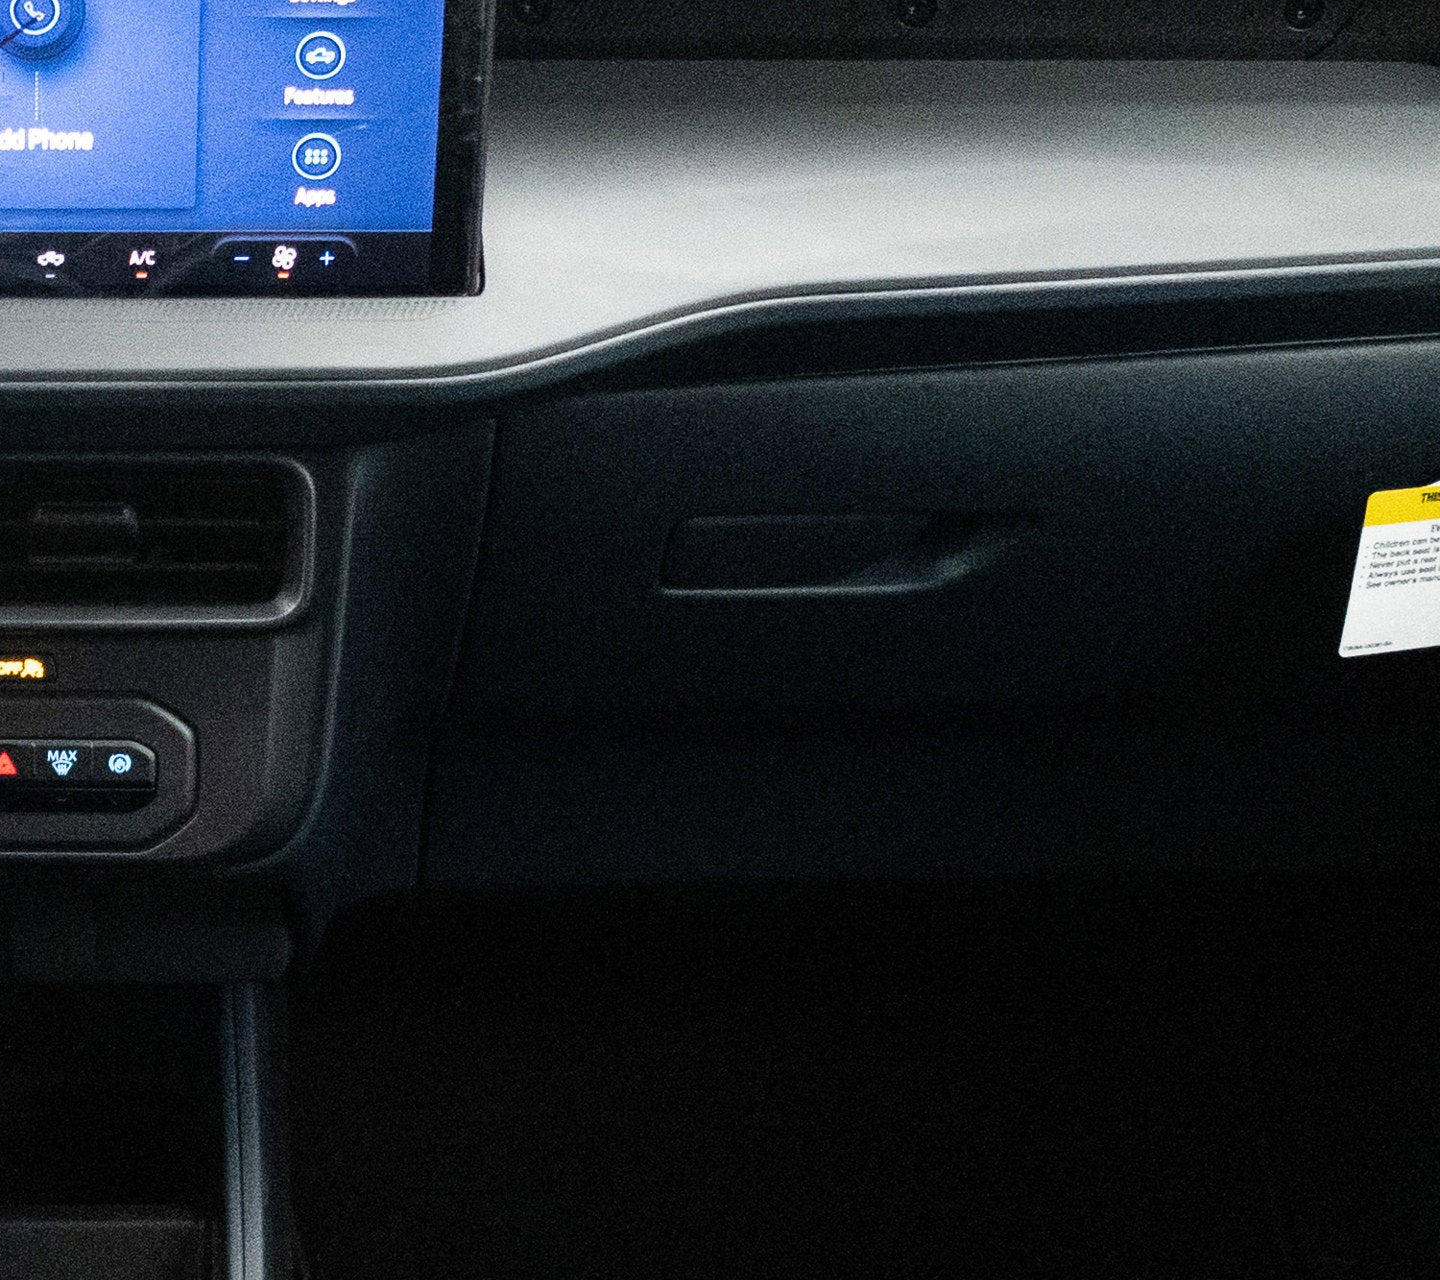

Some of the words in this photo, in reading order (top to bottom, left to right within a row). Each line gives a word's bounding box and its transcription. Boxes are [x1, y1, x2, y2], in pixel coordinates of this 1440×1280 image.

[283, 86, 355, 106] Features
[27, 127, 94, 151] Phone
[294, 186, 336, 207] Apps
[129, 250, 156, 267] A/C
[47, 750, 78, 762] MAX
